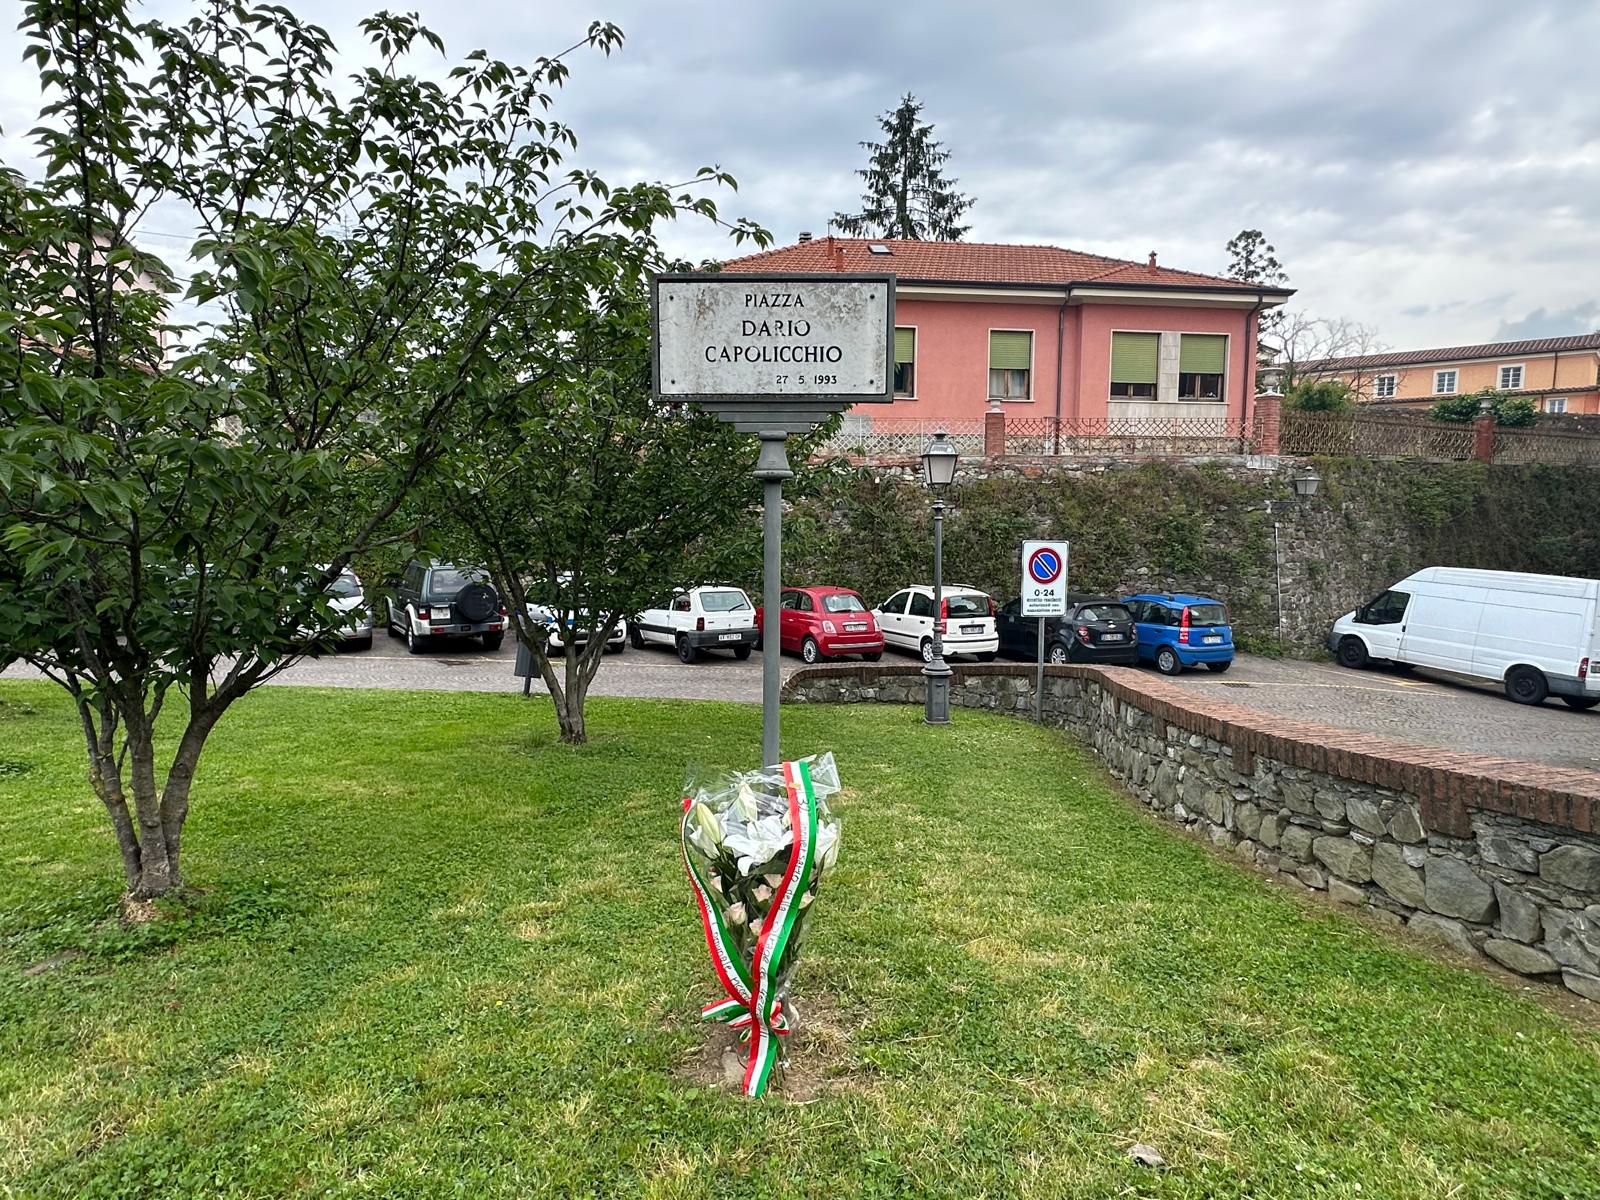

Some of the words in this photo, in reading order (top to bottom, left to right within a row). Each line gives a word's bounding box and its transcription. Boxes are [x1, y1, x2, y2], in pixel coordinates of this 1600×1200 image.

[745, 293, 805, 308] PIAZZA
[741, 319, 811, 337] DARIO
[705, 345, 843, 363] CAPOLICCHIO
[776, 375, 789, 385] 27
[798, 375, 805, 385] 5
[814, 375, 837, 385] 1993
[1034, 589, 1055, 597] 0-24
[780, 889, 797, 911] della
